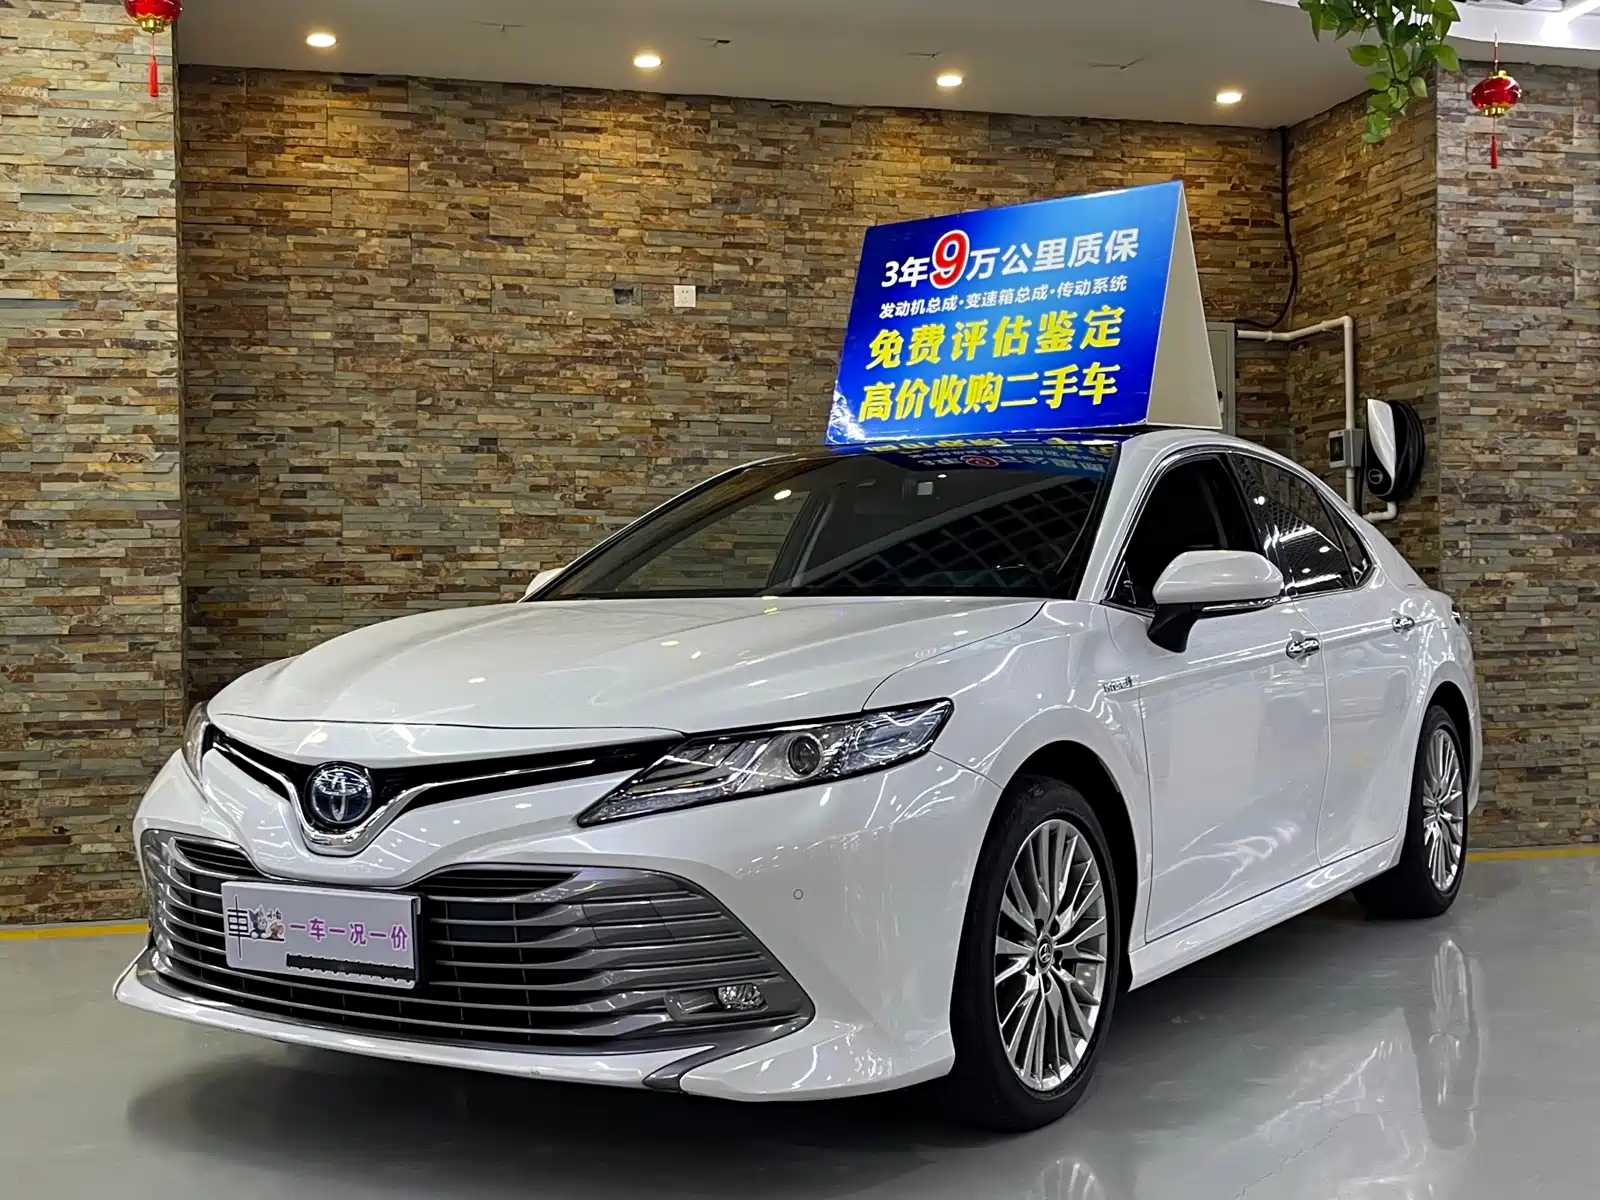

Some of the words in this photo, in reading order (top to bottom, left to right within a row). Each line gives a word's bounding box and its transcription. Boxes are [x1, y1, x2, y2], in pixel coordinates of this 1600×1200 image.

[881, 228, 1139, 290] 3年9万公里质保
[865, 304, 1126, 371] 免费评估鉴定
[858, 361, 1121, 422] 高价收购二手车
[289, 917, 408, 951] 一车一况一价
